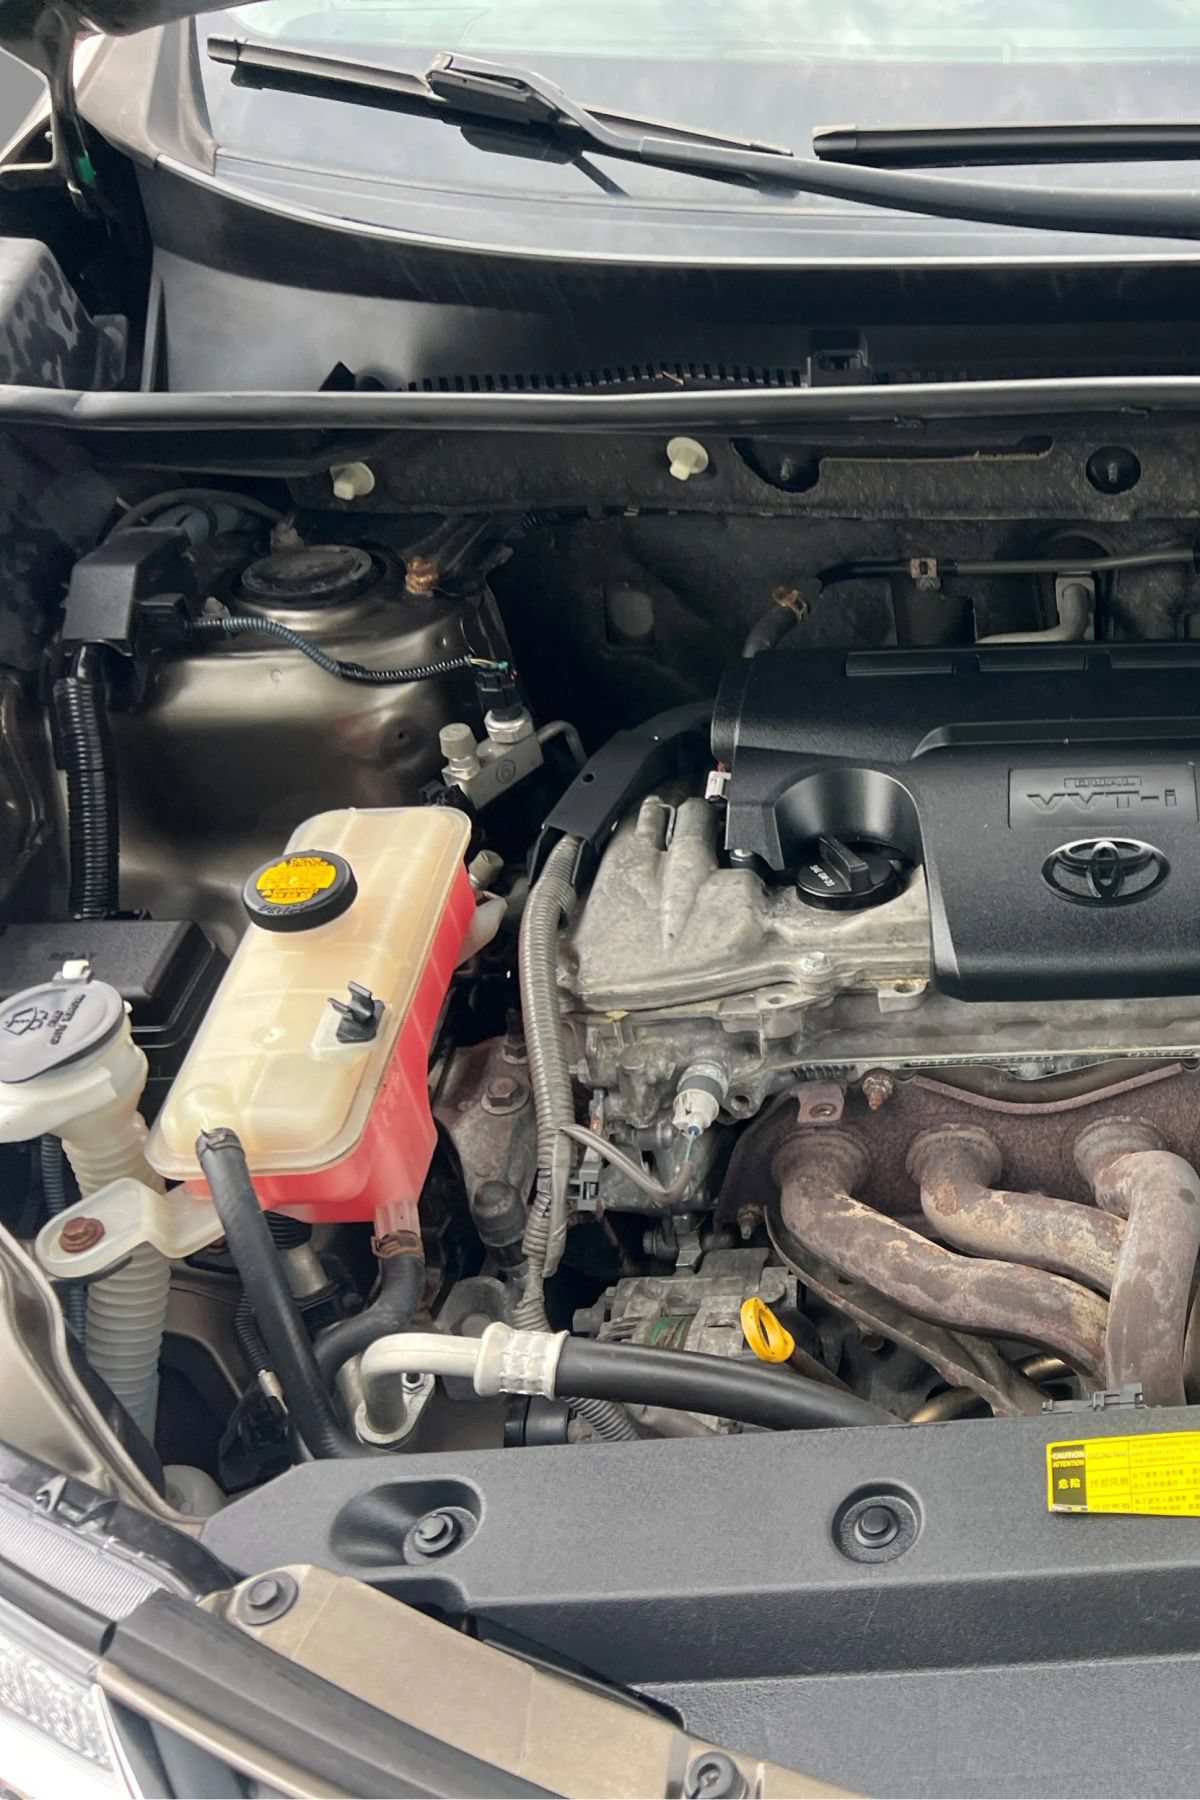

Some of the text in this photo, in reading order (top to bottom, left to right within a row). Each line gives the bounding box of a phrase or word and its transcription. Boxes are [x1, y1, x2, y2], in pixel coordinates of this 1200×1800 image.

[1027, 789, 1177, 811] VVT-i
[1052, 1450, 1085, 1460] CAUTION
[1052, 1459, 1085, 1468] ATTENTION
